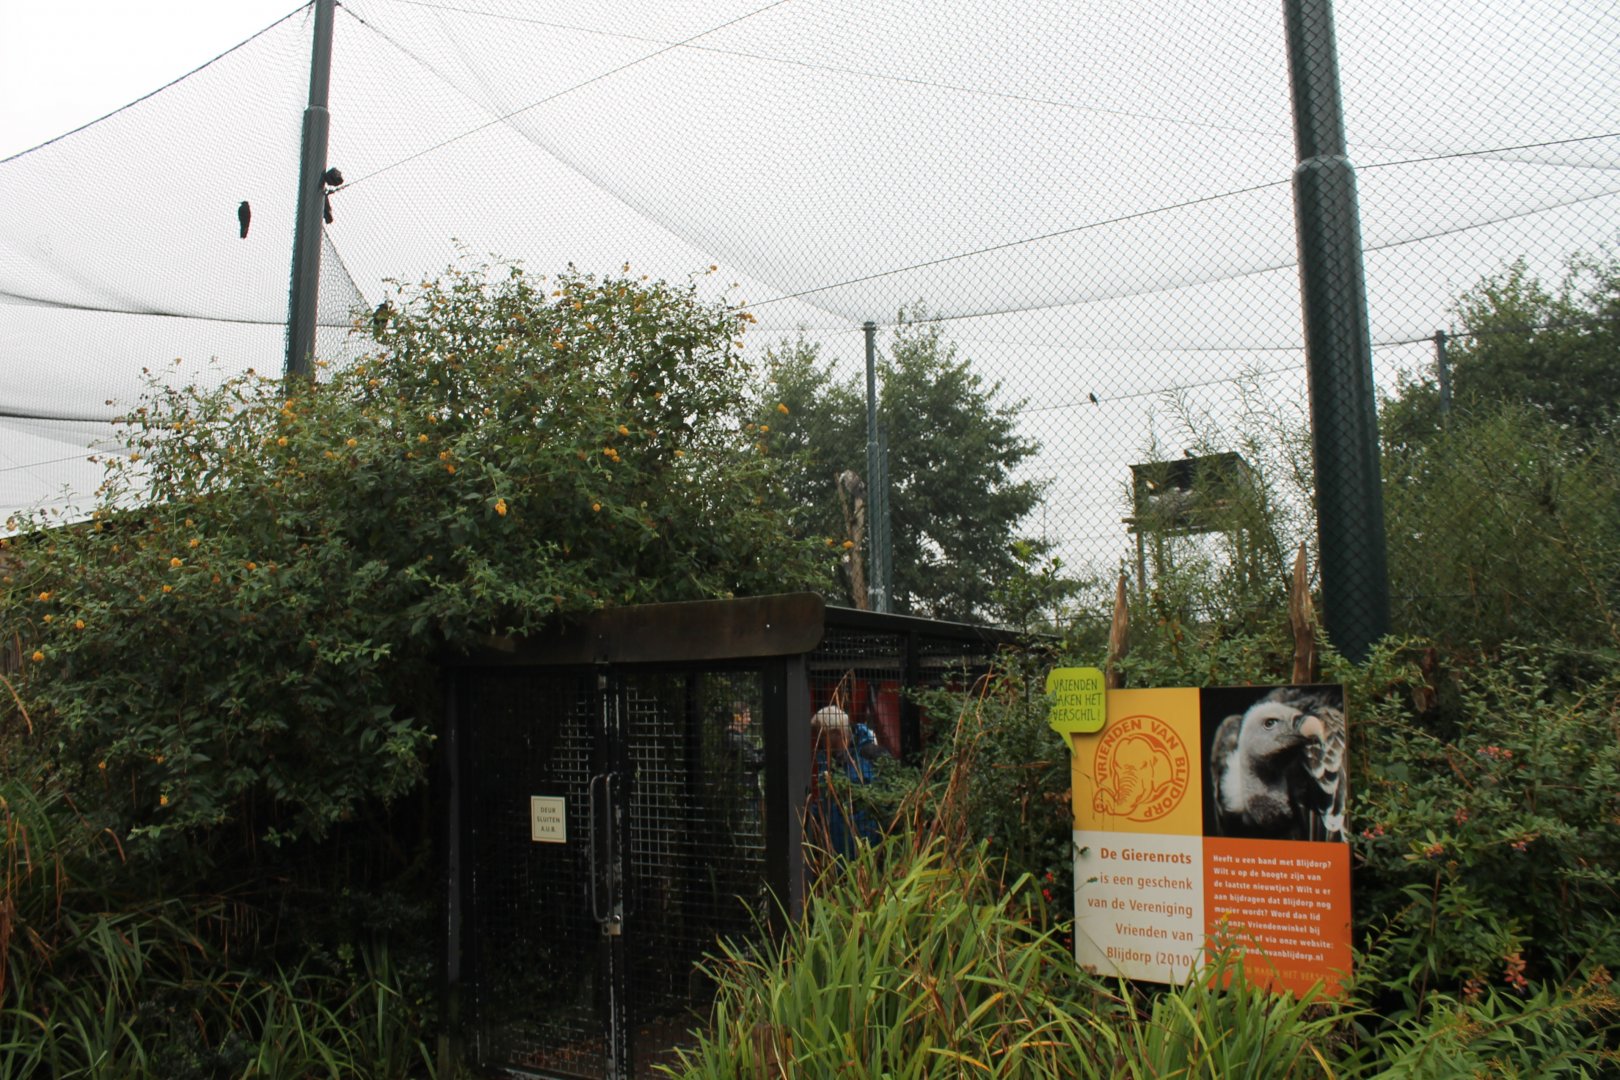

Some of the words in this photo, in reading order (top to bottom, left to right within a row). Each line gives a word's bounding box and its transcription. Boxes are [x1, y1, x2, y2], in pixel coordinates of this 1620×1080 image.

[1053, 679, 1098, 691] VRIENDEN
[1052, 693, 1082, 707] AKEN
[1085, 692, 1102, 706] HET
[1151, 721, 1179, 750] VAN
[1098, 719, 1141, 782] VRIENDEN
[1144, 756, 1186, 817] BLIJDORP
[1101, 848, 1116, 859] De
[1122, 849, 1192, 864] Gierenrots
[1213, 855, 1232, 863] Heeft
[1258, 857, 1276, 865] band
[1296, 859, 1331, 869] Blijdorp?
[1100, 872, 1108, 883] is
[1113, 875, 1133, 885] een
[1138, 876, 1193, 889] geschenk
[1261, 870, 1287, 880] hoogte
[1290, 872, 1304, 881] zijn
[1225, 881, 1250, 889] laatste
[1253, 882, 1294, 893] nieuwtjes?
[1088, 898, 1107, 908] van
[1112, 898, 1128, 909] de
[1130, 900, 1193, 918] Vereniging
[1230, 894, 1265, 904] bijdragen
[1268, 896, 1280, 904] dat
[1283, 897, 1313, 908] Blijdorp
[1316, 901, 1331, 910] nog
[1242, 908, 1268, 916] wordt?
[1271, 910, 1290, 918] Word
[1293, 912, 1307, 920] dan
[1310, 912, 1320, 921] lid
[1116, 923, 1167, 938] Vrienden
[1172, 931, 1193, 941] van
[1248, 921, 1307, 933] Vriendenwinkel
[1309, 924, 1320, 936] bij
[1300, 938, 1334, 948] website:
[1107, 947, 1151, 963] Blijdorp
[1156, 952, 1193, 966] (2010)
